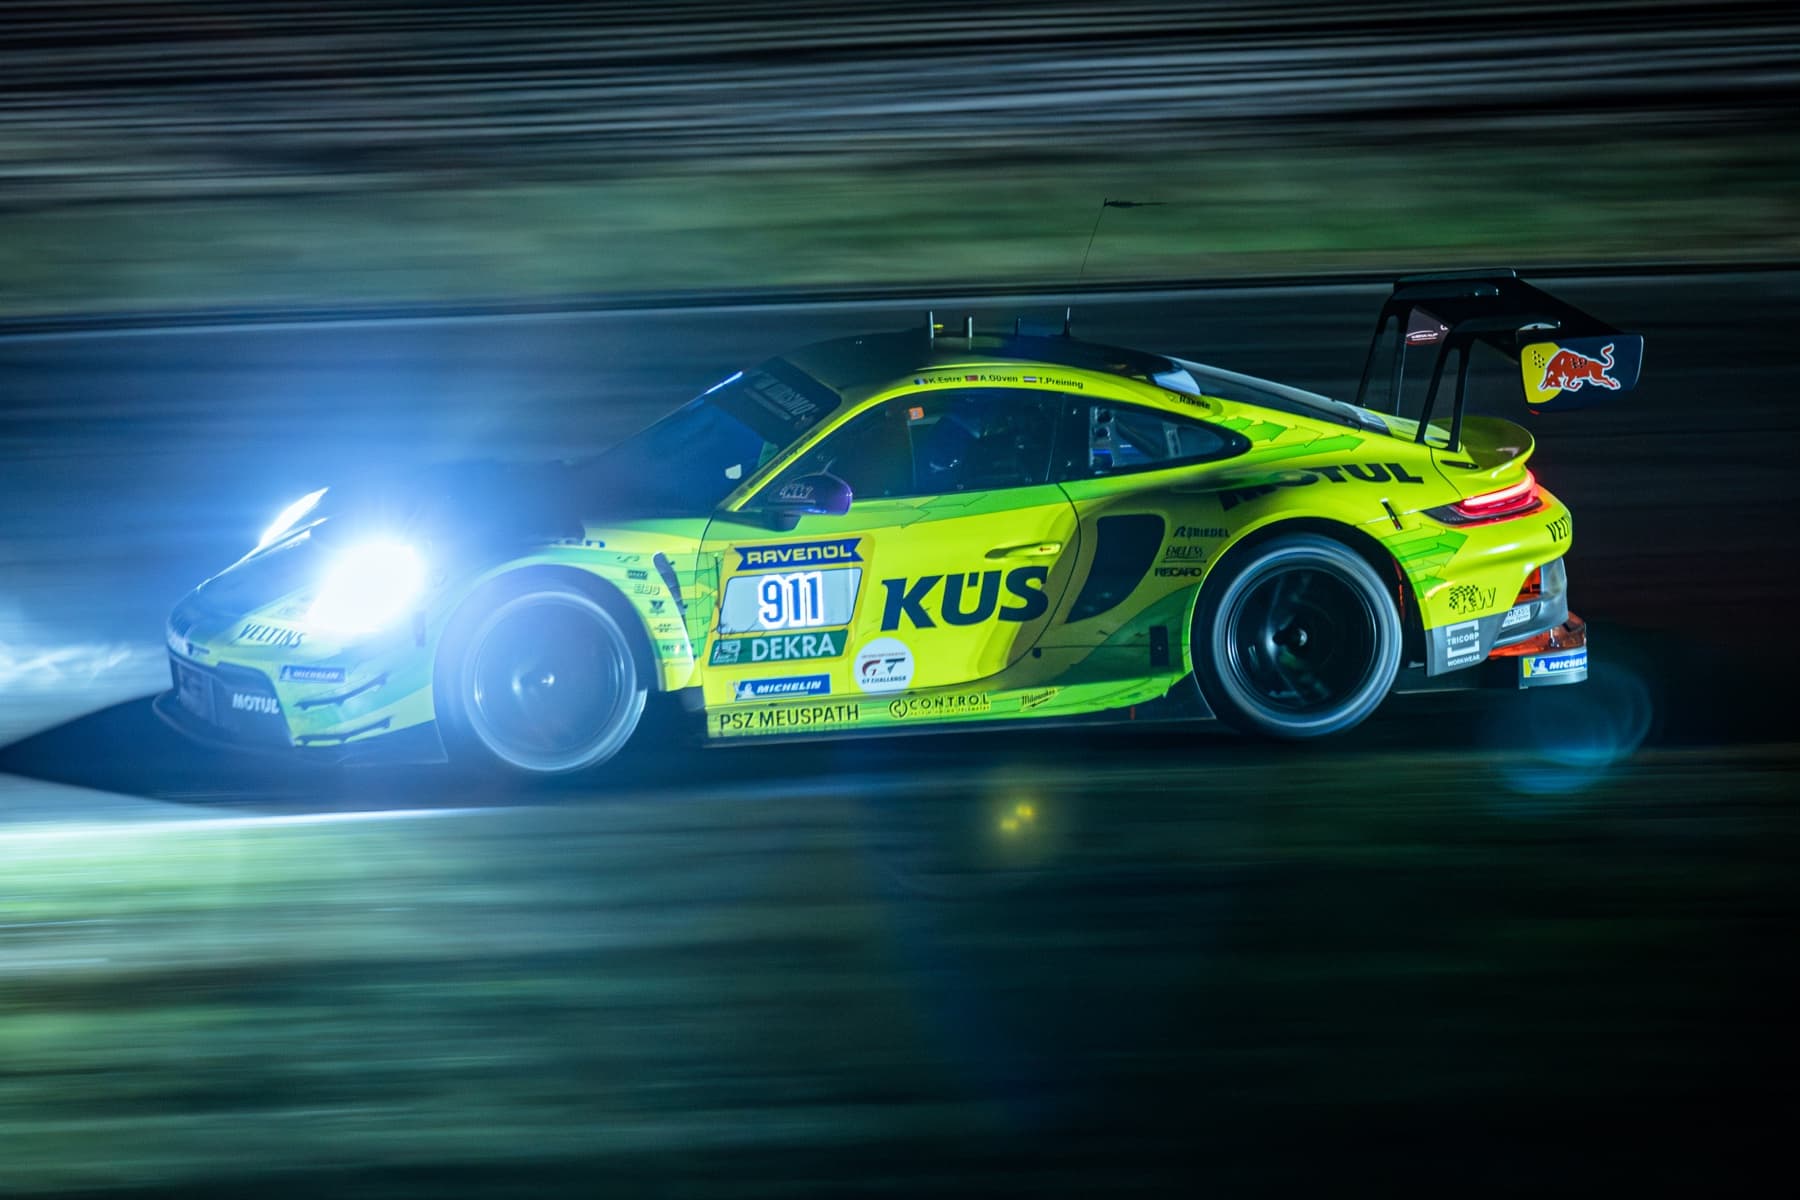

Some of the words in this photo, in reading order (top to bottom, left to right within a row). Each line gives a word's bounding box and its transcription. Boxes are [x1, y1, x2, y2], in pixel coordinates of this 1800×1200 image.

[747, 544, 852, 565] RAVENOL
[1155, 568, 1202, 577] RECARO
[758, 571, 824, 630] 911
[880, 565, 1049, 632] KÜS
[239, 623, 308, 649] VELTINS
[1447, 631, 1480, 646] TRICORP
[751, 633, 836, 662] DEKRA
[1447, 654, 1481, 667] WORKWEAR
[756, 680, 822, 694] MICHELIN
[232, 693, 280, 715] MOTUL
[909, 693, 989, 711] CONTROL
[719, 711, 755, 731] PSZ
[759, 703, 860, 728] MEUSPATH
